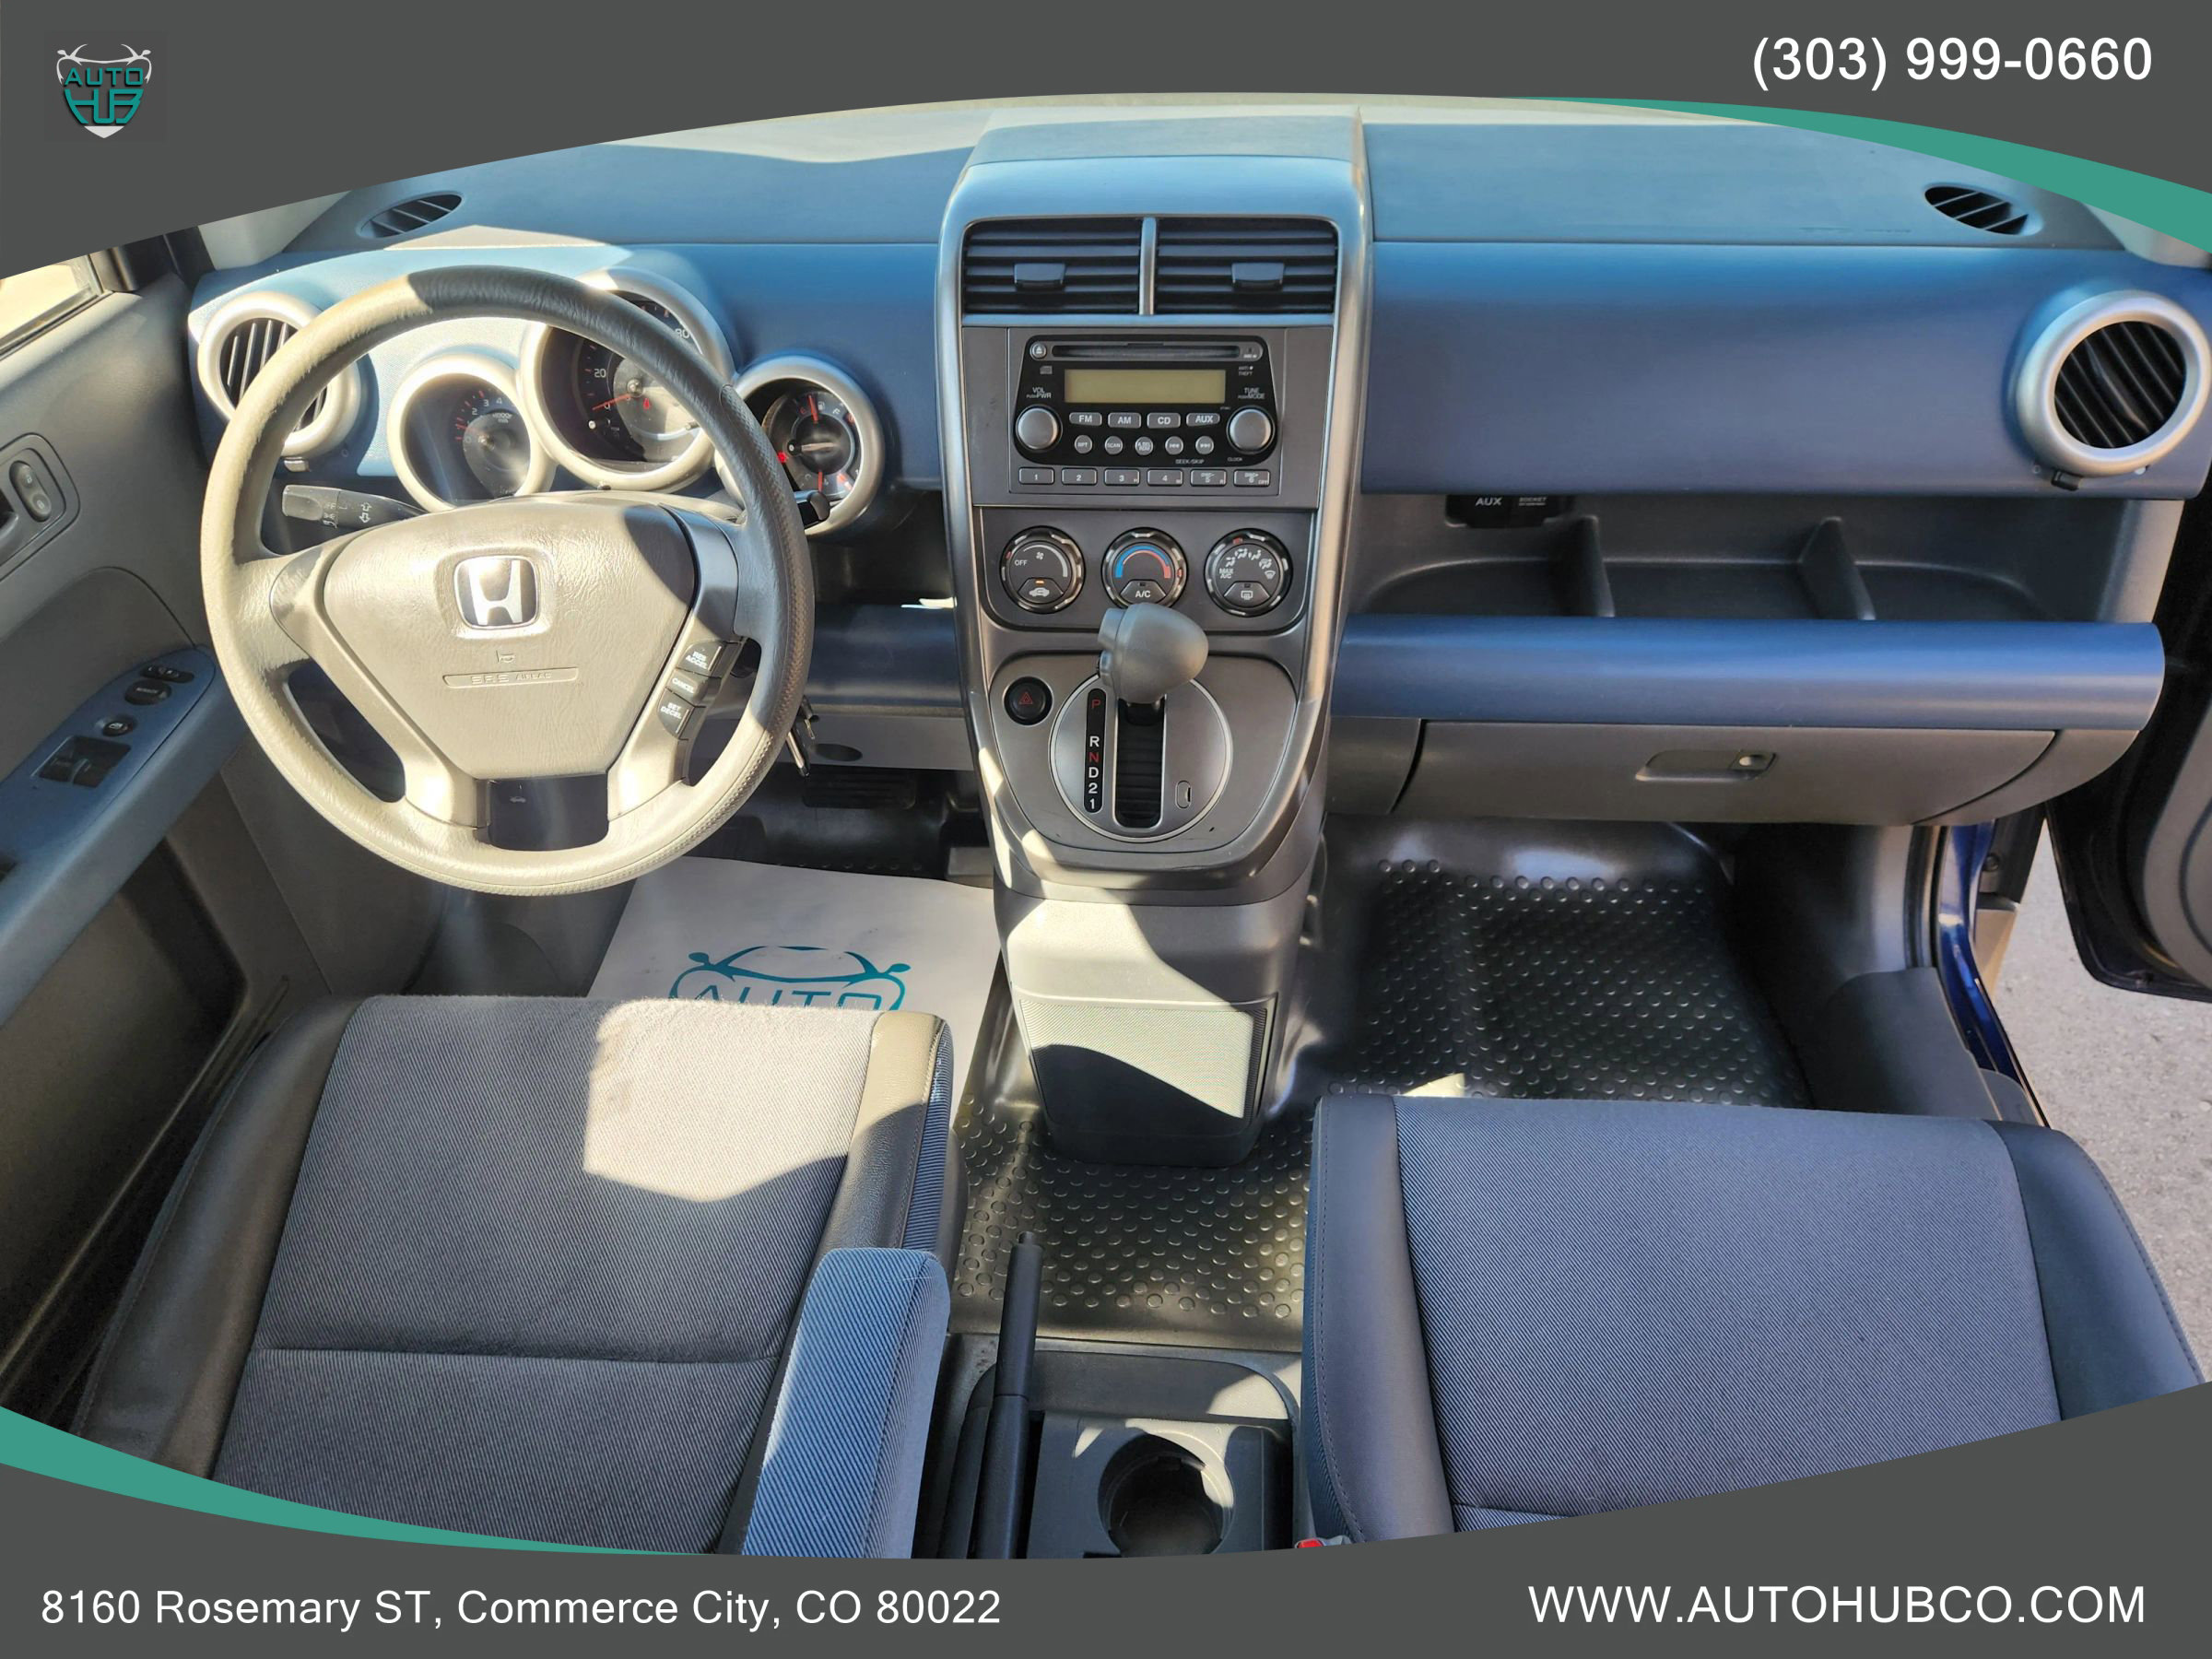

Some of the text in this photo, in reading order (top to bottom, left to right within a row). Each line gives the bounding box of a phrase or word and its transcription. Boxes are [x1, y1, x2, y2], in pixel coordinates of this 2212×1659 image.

[594, 369, 606, 378] 20
[1078, 415, 1093, 423] FM
[1117, 416, 1132, 425] AM
[1157, 417, 1171, 425] CD
[1194, 415, 1214, 423] AUX
[1475, 497, 1503, 506] AUX
[1135, 589, 1151, 598] A/C
[1090, 699, 1101, 711] P
[1089, 735, 1100, 747] R
[1089, 752, 1100, 763] N
[1088, 767, 1100, 779] D
[1088, 782, 1098, 794] 2
[1089, 798, 1095, 810] 1
